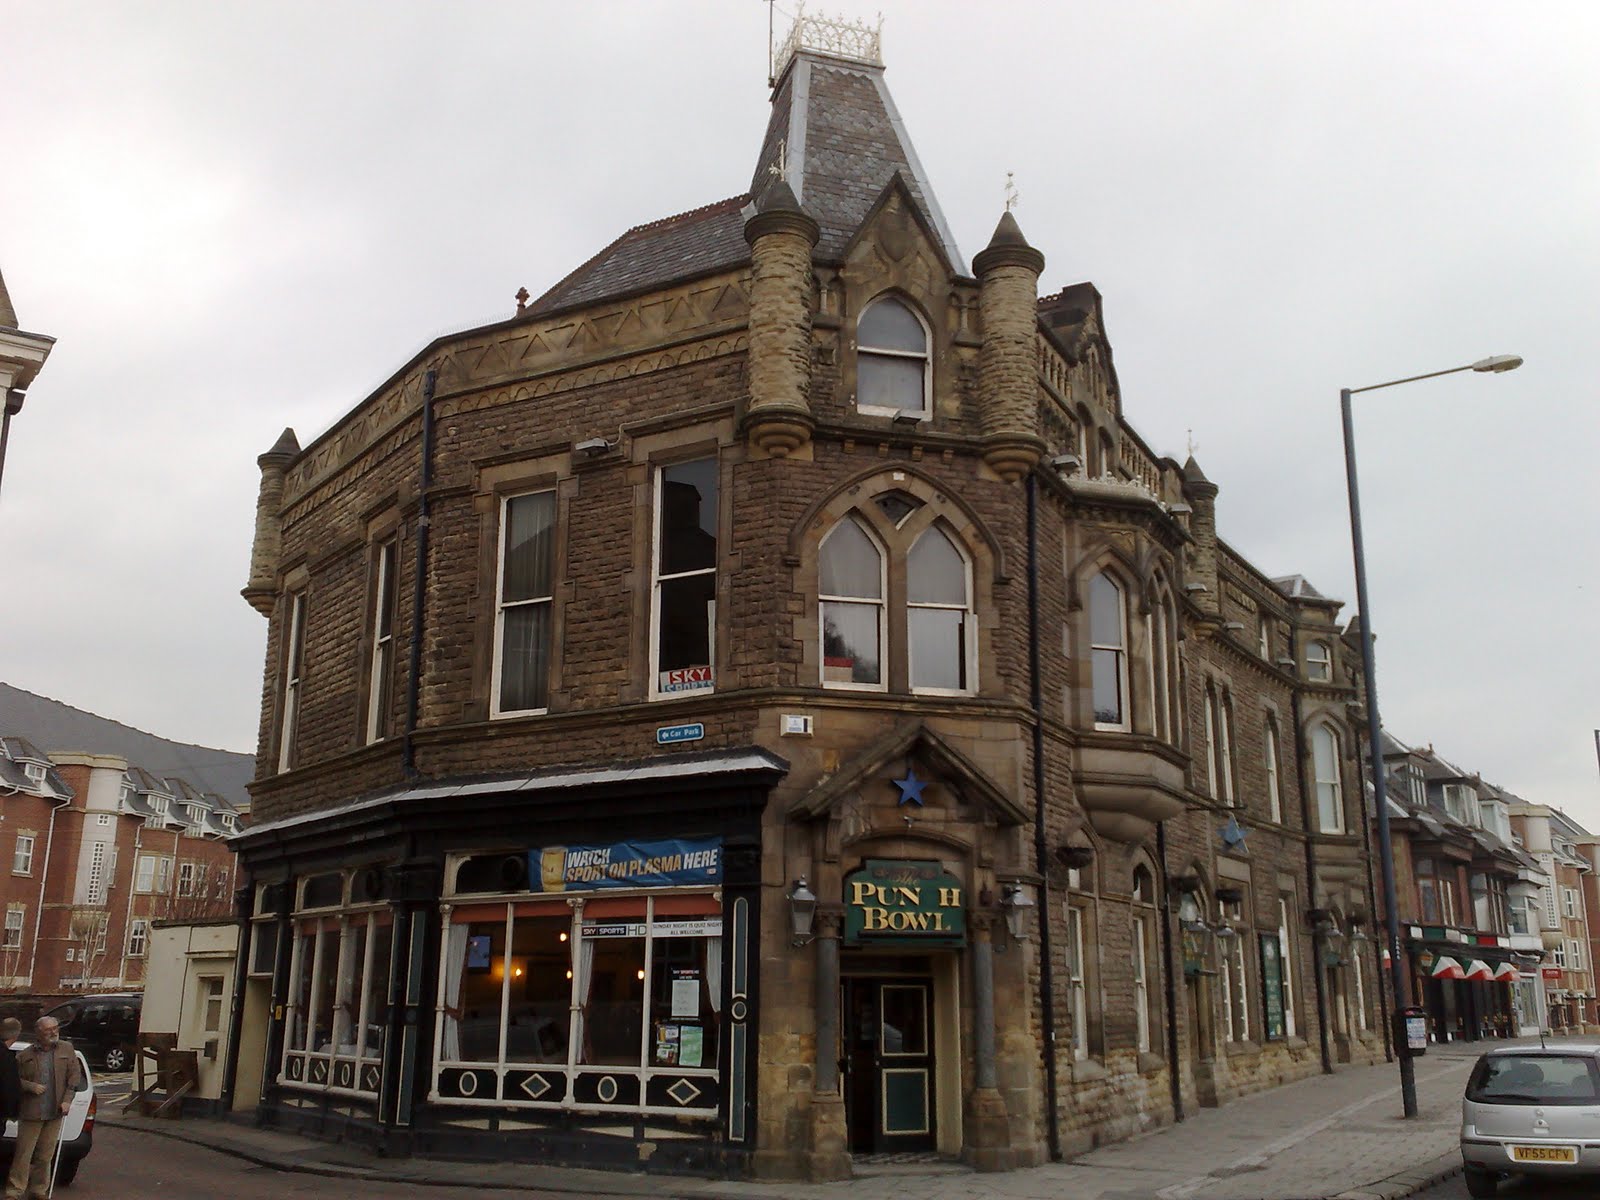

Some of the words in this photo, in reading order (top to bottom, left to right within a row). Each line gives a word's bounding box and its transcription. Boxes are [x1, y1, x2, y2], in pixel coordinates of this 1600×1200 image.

[671, 669, 706, 684] SKY
[684, 728, 699, 736] Park
[566, 864, 608, 882] SPORT
[608, 861, 627, 878] ON
[629, 854, 681, 876] PLASMA
[683, 849, 718, 869] HERE
[568, 848, 611, 868] WATCH
[862, 906, 951, 931] BOWL
[583, 928, 596, 936] SKY
[599, 927, 625, 936] SPORTS
[627, 925, 647, 936] HD
